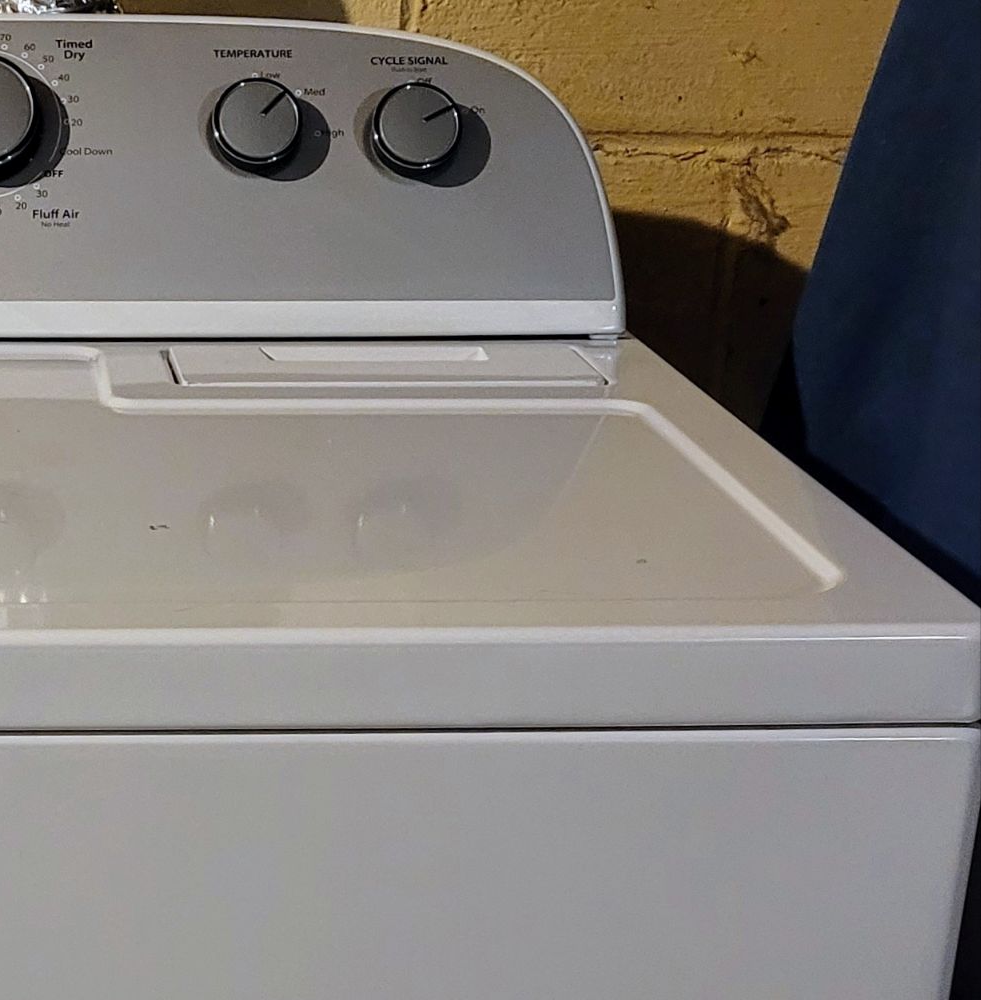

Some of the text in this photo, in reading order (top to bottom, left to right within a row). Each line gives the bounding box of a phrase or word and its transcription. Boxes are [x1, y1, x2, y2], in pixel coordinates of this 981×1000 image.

[0, 33, 12, 42] 70
[23, 43, 36, 51] 60
[55, 39, 93, 49] Timed
[63, 50, 86, 61] Dry
[213, 49, 293, 59] TEMPERATURE
[42, 55, 55, 63] 50
[370, 56, 449, 66] CYCLE SIGNAL
[58, 73, 70, 82] 40
[260, 71, 281, 79] Low
[303, 88, 326, 97] Med
[67, 95, 80, 104] 30
[71, 118, 83, 127] 20
[84, 147, 113, 156] Down
[44, 170, 64, 178] OFF
[35, 190, 49, 198] 30
[15, 202, 28, 210] 20
[32, 208, 80, 219] Fluff Air
